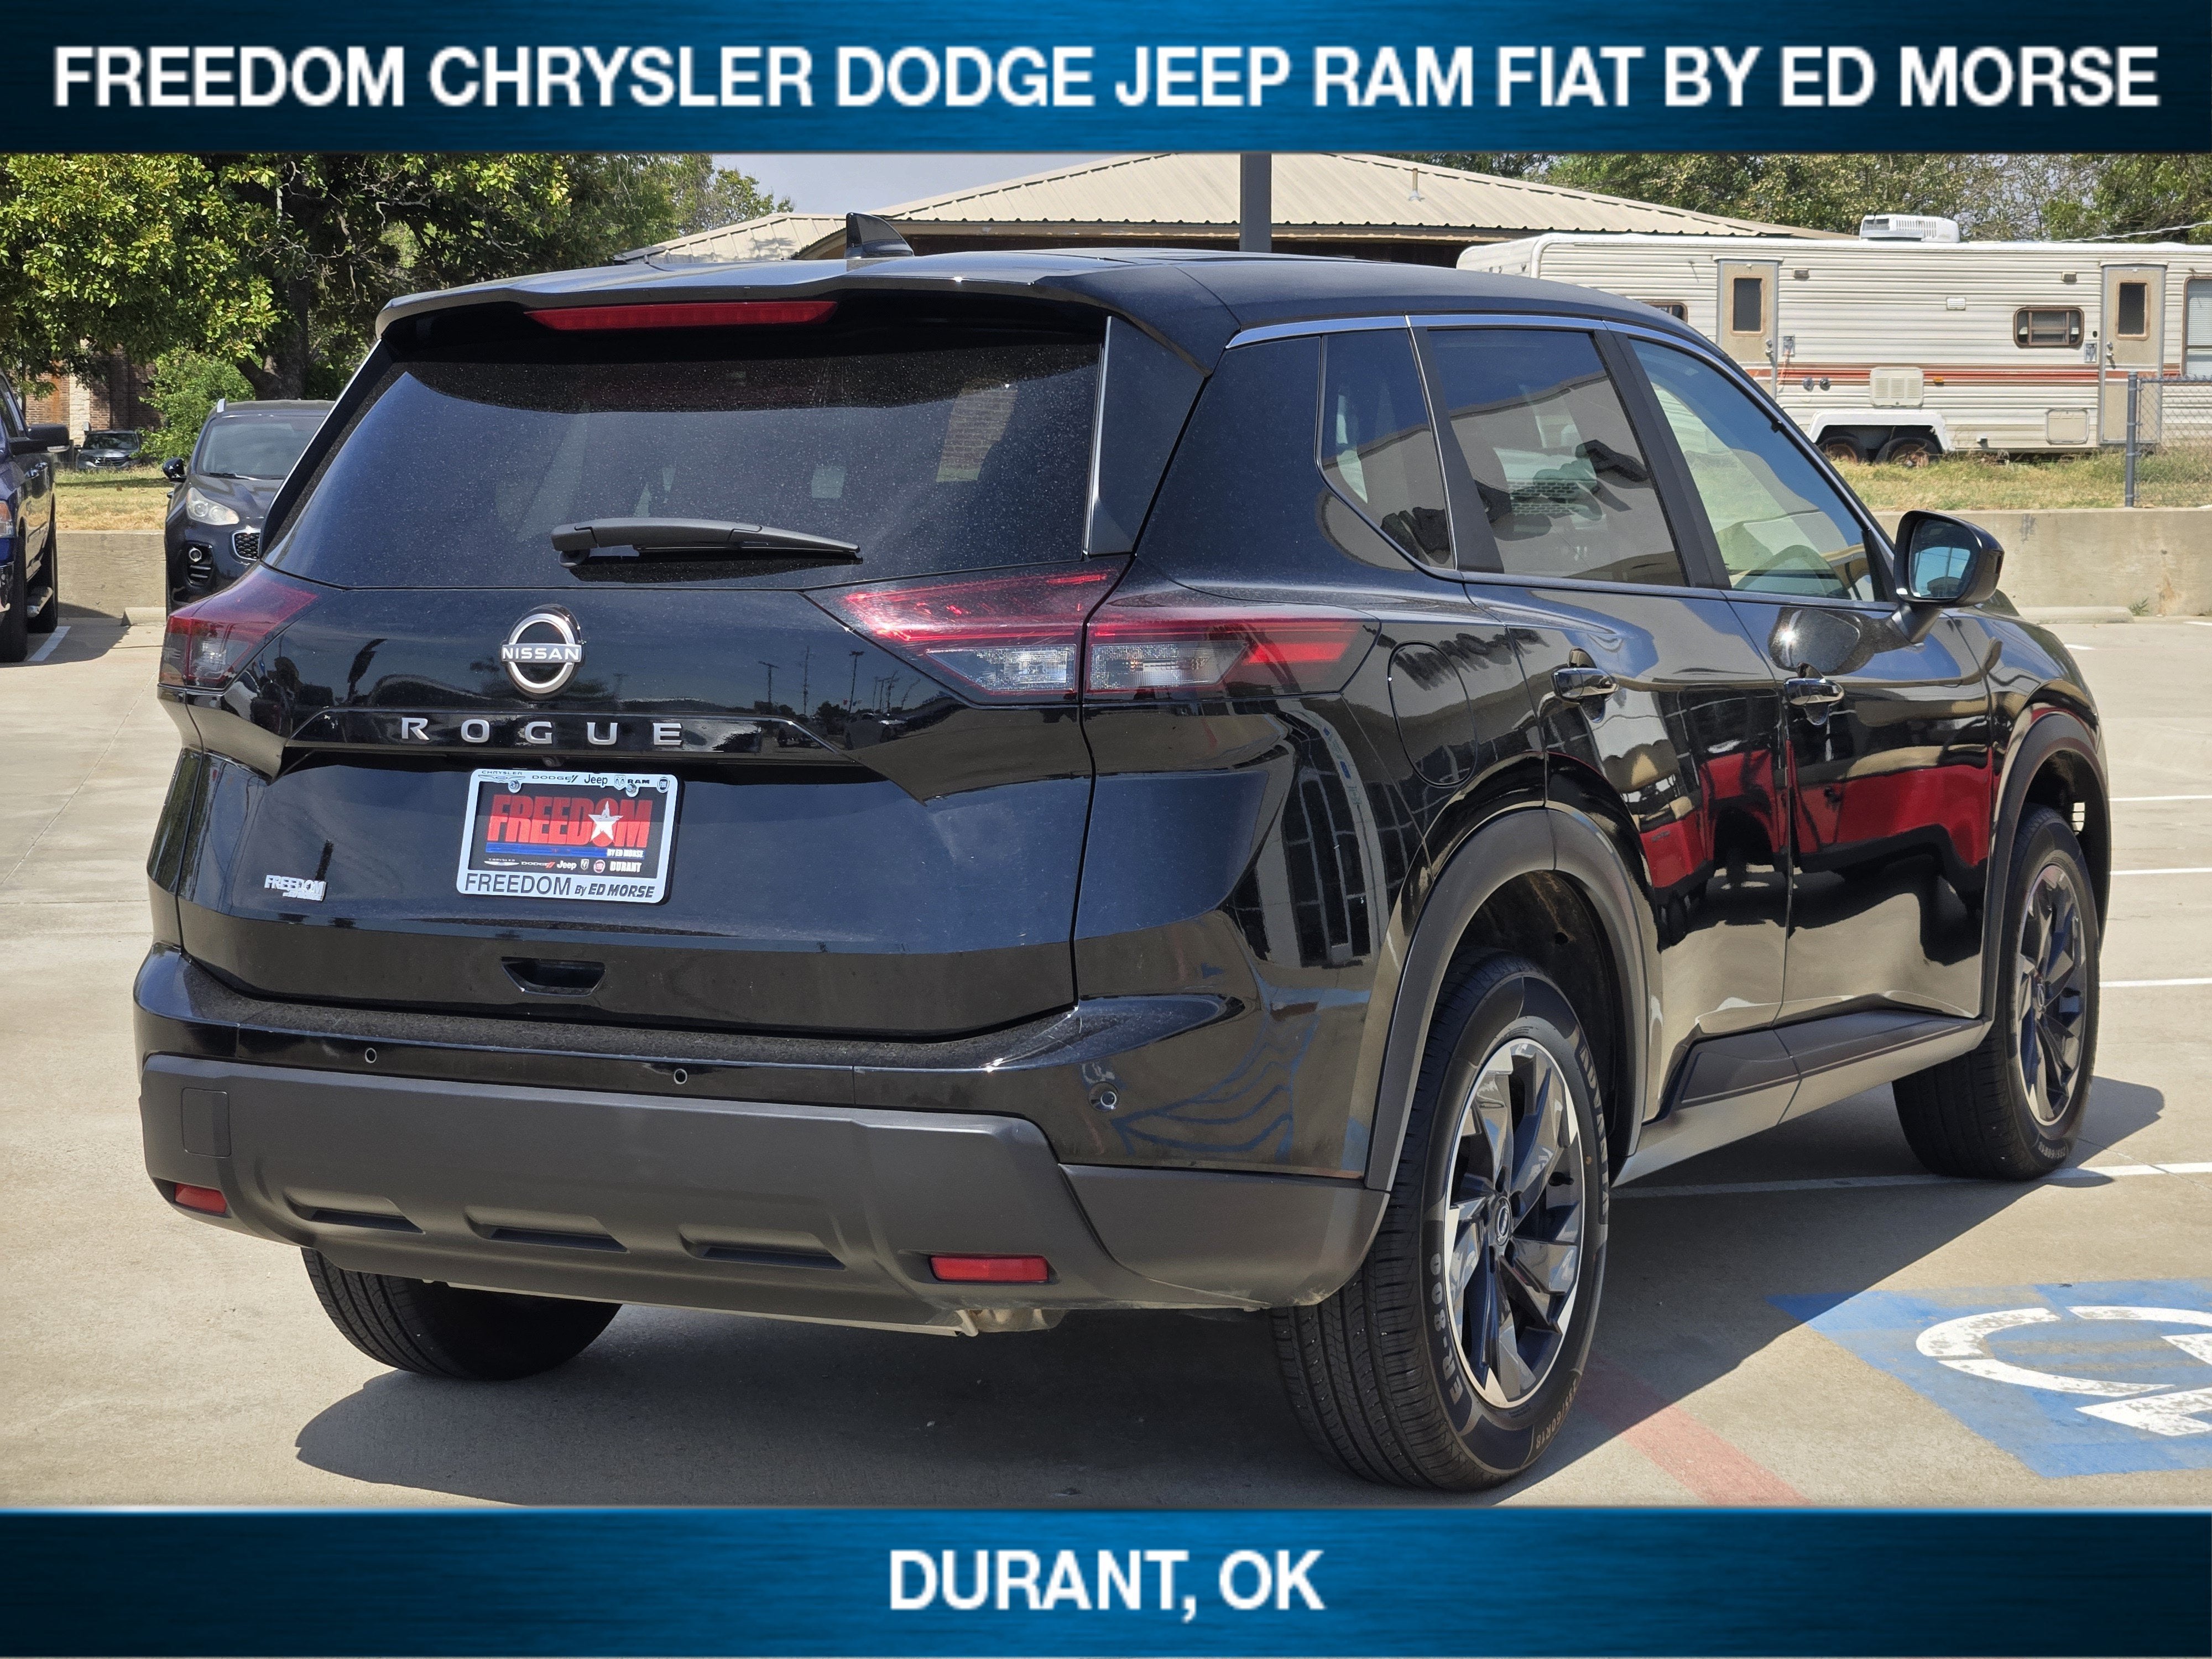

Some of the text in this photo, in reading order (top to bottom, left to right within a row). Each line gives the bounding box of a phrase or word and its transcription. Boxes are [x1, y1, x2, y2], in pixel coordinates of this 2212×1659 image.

[502, 646, 580, 661] NISSAN
[401, 717, 682, 746] ROGUE
[584, 774, 608, 786] Jeep
[487, 794, 654, 848] FREEDOM
[556, 860, 577, 870] Jeep
[609, 860, 642, 873] DURANT
[264, 874, 326, 895] FREEDOM
[465, 873, 655, 898] FREEDOM By ED MORSE
[1430, 1253, 1464, 1405] ER-800
